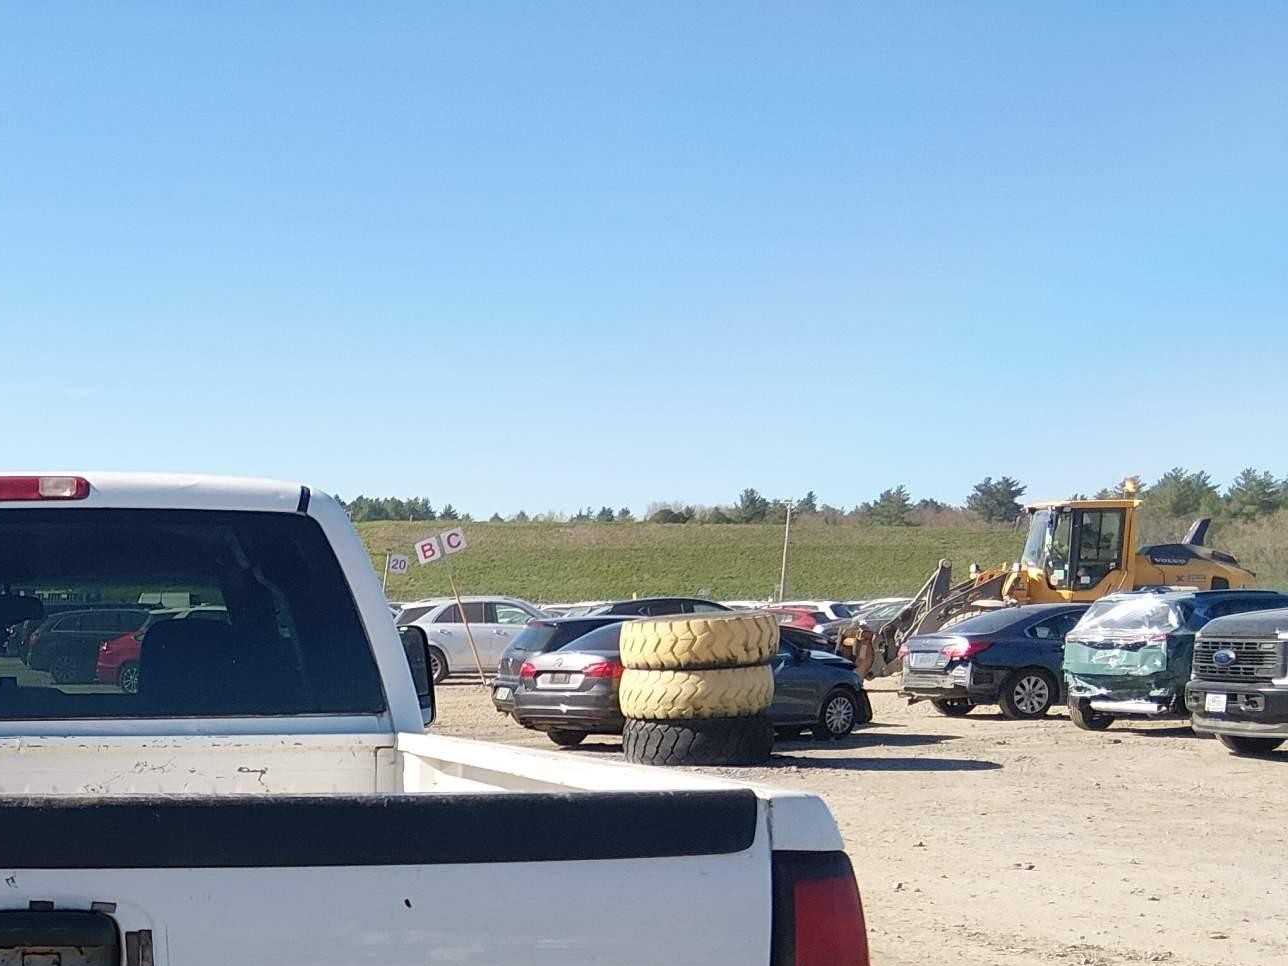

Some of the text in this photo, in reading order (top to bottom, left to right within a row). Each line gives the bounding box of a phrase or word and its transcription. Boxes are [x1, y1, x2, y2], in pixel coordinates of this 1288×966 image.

[420, 532, 462, 560] B C
[391, 558, 407, 570] 20
